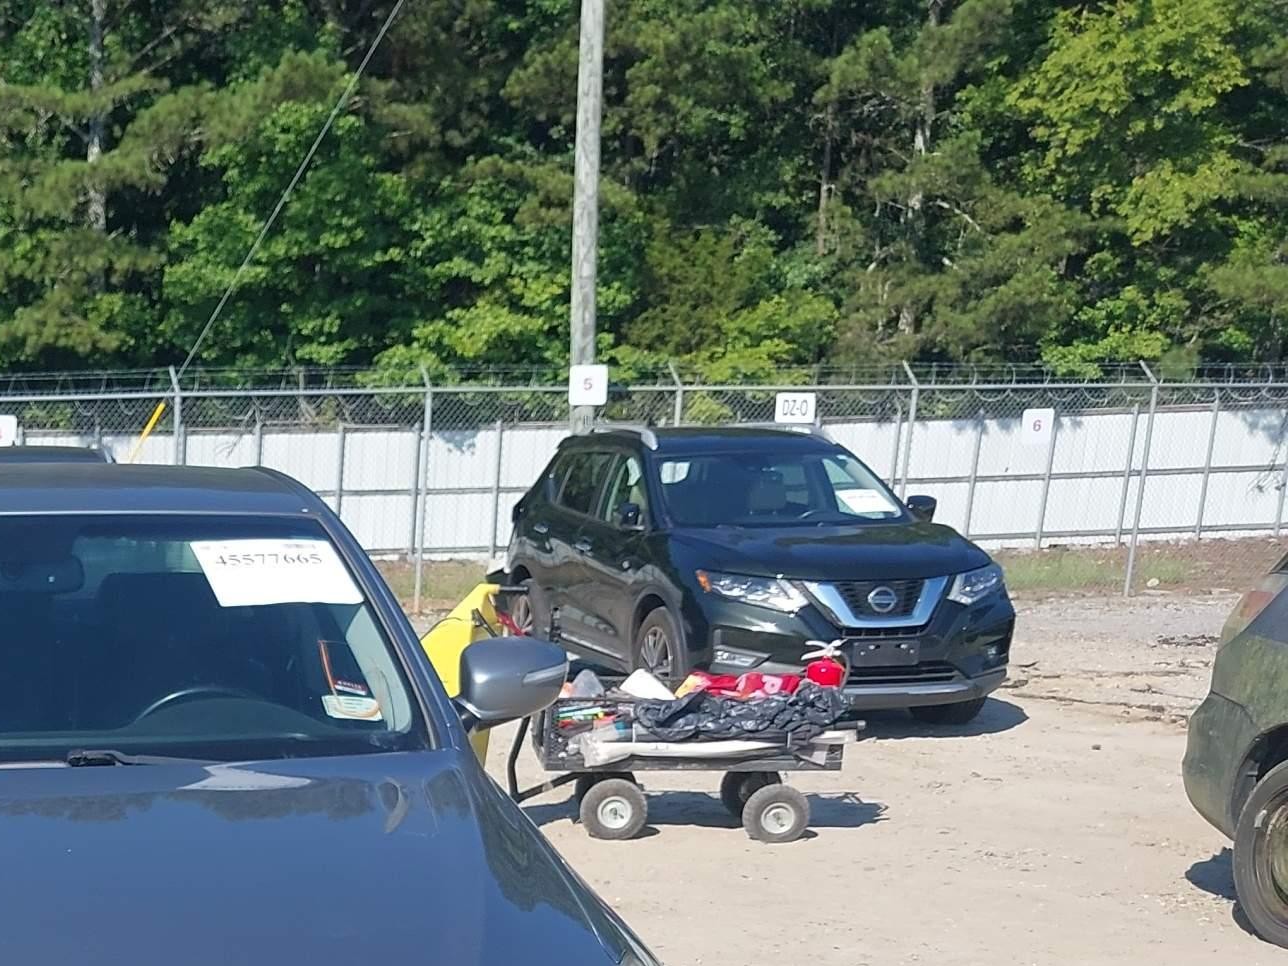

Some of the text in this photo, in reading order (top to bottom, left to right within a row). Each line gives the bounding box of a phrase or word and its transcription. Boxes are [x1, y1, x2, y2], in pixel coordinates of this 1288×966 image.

[583, 377, 593, 391] 5
[1032, 419, 1042, 432] 6
[215, 553, 323, 566] 45577665
